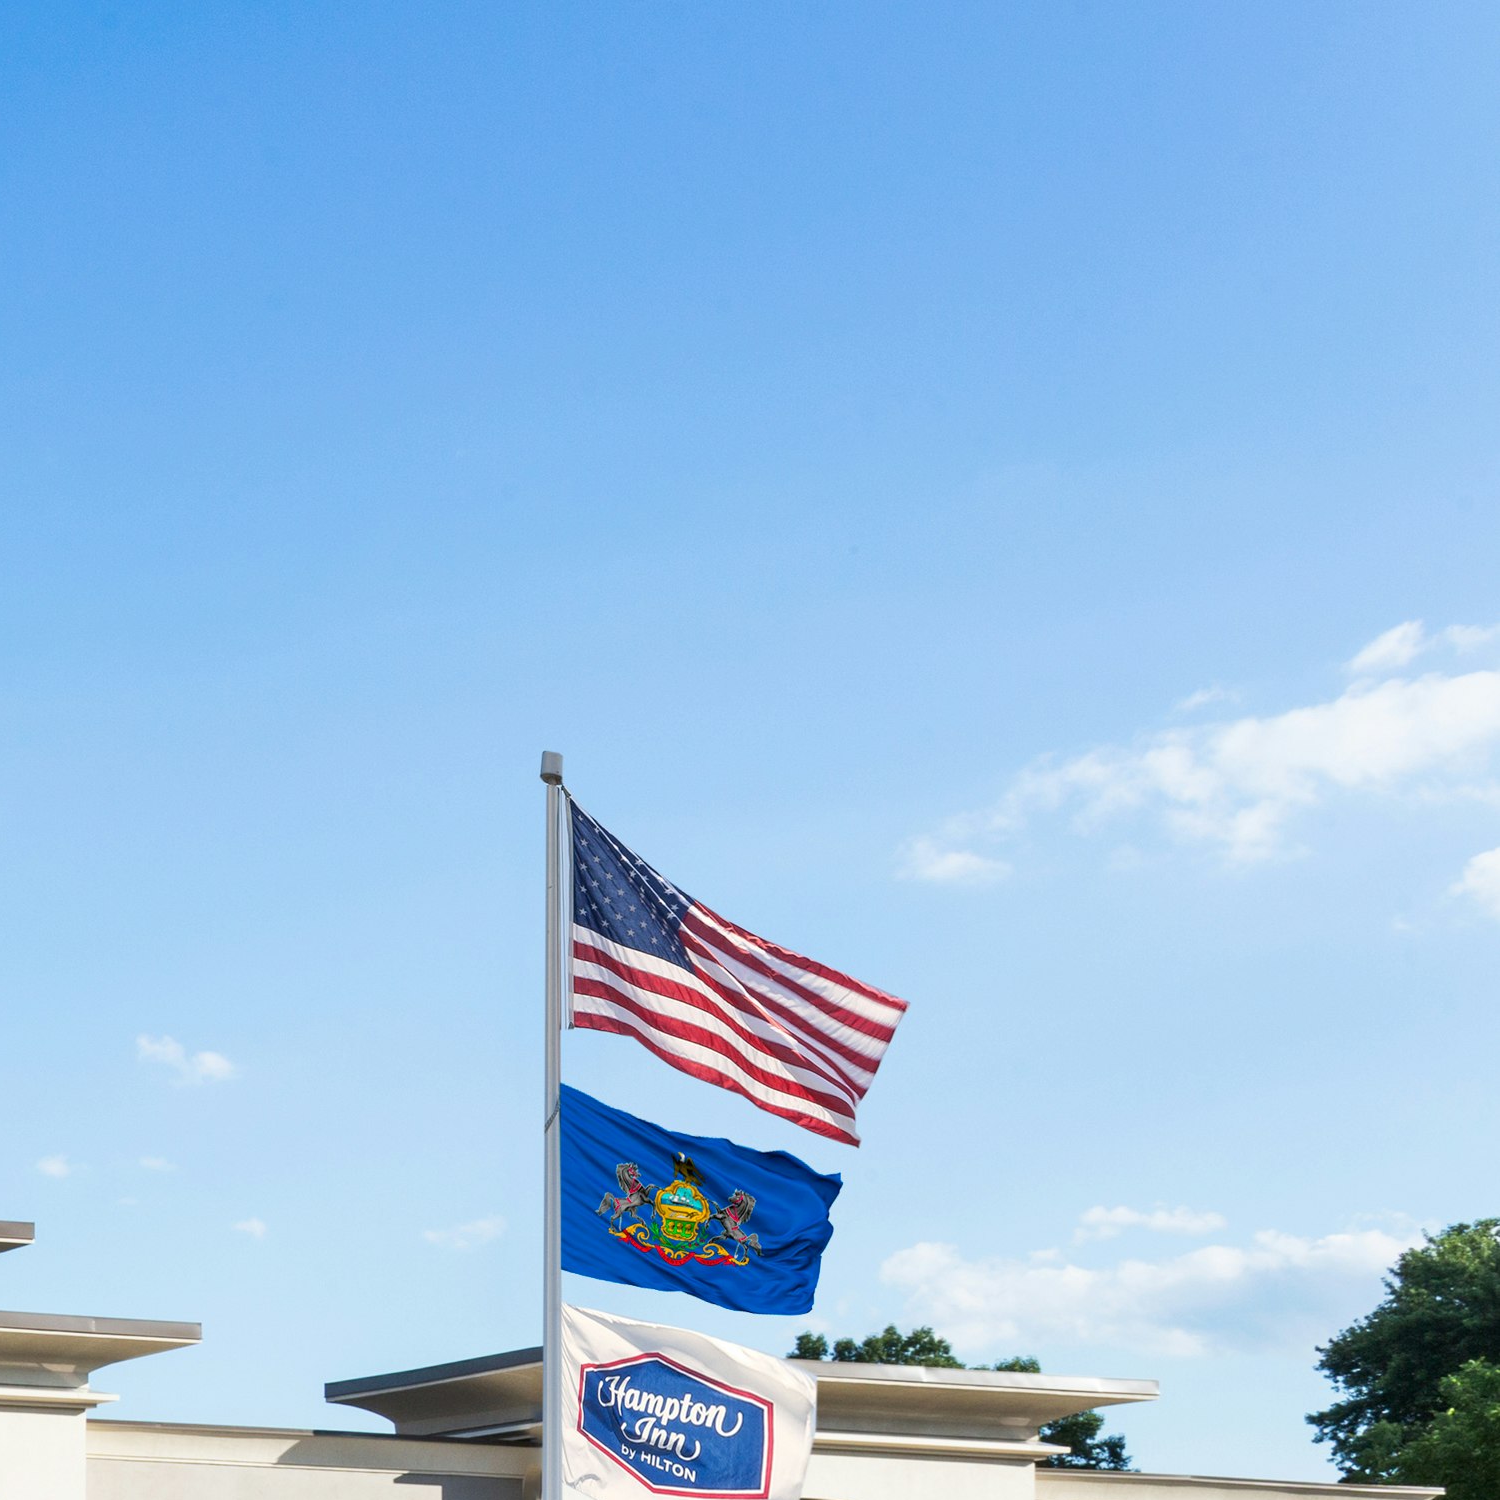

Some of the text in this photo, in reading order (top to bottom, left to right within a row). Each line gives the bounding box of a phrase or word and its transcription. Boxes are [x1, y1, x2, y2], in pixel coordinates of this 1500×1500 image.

[597, 1375, 743, 1437] Hampton
[621, 1416, 701, 1461] Inn
[621, 1443, 696, 1483] by HILTON
